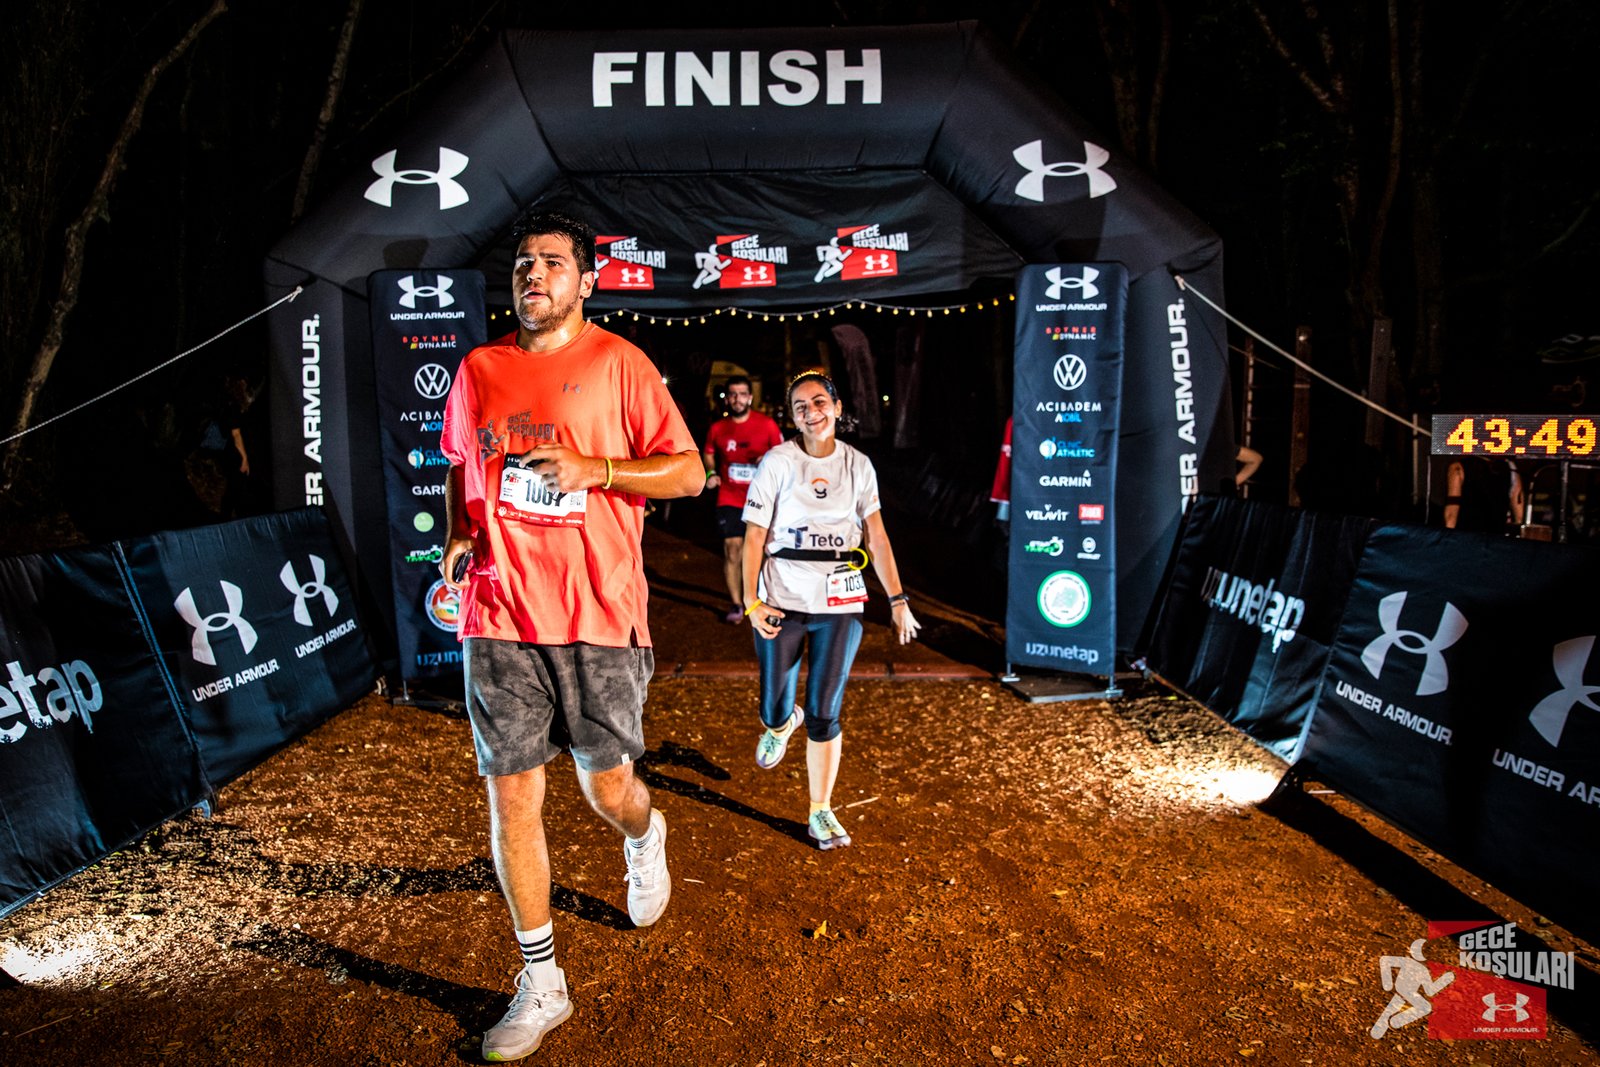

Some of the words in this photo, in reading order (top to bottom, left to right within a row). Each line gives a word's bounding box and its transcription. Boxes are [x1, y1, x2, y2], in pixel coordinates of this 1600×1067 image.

[592, 49, 882, 107] FINISH
[851, 224, 880, 241] GECE
[610, 236, 638, 251] GECE
[731, 235, 759, 251] GECE
[1036, 303, 1067, 311] UNDER
[1067, 302, 1107, 310] ARMOUR
[390, 312, 424, 320] UNDER
[424, 311, 465, 319] ARMOUR
[402, 334, 456, 343] BOYNER
[418, 341, 456, 349] DYNAMIC
[400, 411, 442, 421] ACIBA
[1446, 418, 1597, 454] 43:49
[1039, 475, 1092, 487] GARMIN
[809, 534, 844, 547] Teto
[295, 637, 326, 658] UNDER
[325, 618, 356, 643] ARMOUR
[1025, 642, 1099, 665] uzunetap
[192, 676, 234, 703] UNDER
[234, 659, 280, 686] ARMOUR
[1335, 680, 1383, 714] UNDER
[1492, 748, 1565, 792] UNDER
